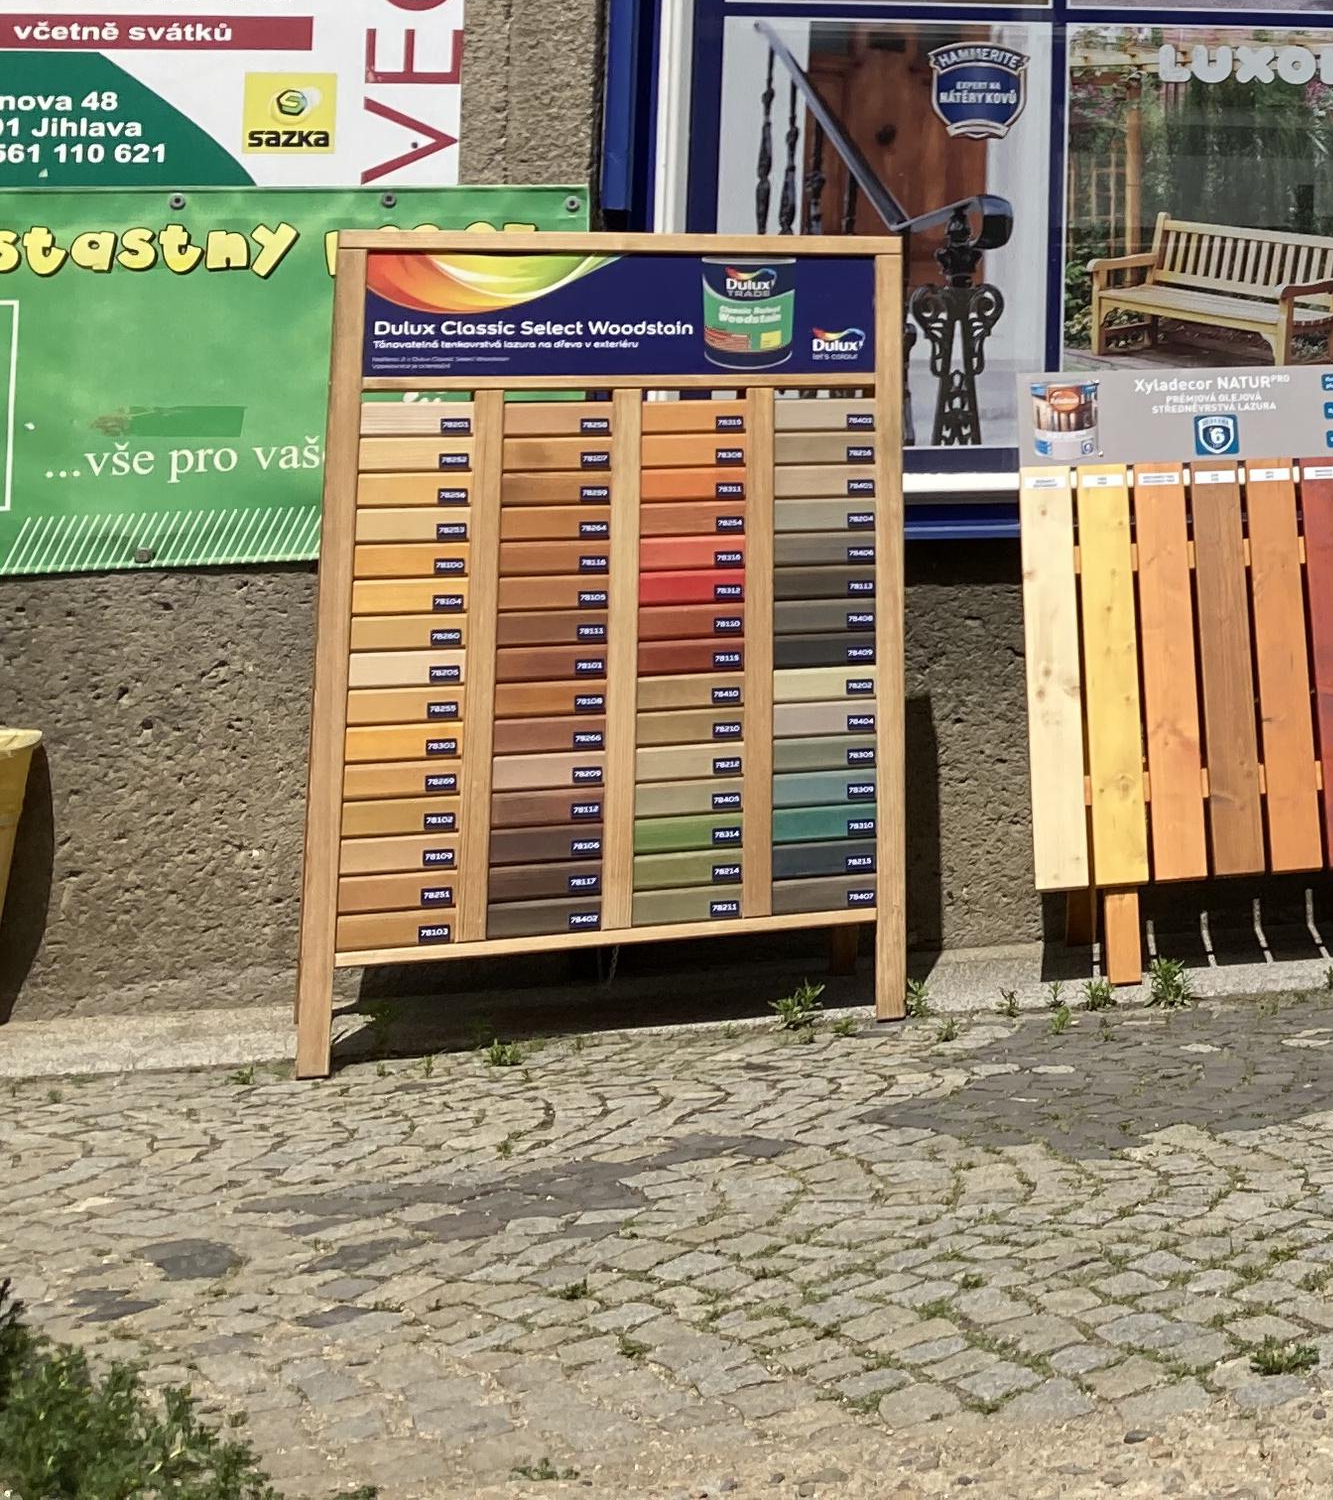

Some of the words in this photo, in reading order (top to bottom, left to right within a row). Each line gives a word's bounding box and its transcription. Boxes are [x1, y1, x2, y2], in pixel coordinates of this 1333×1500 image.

[13, 21, 119, 41] včetně
[128, 21, 233, 43] svátků
[937, 48, 1020, 69] HAMMERITE
[81, 91, 118, 111] 48
[31, 117, 142, 137] Jihlava
[247, 129, 331, 150] sazka
[53, 143, 105, 163] 110
[114, 143, 165, 163] 621
[726, 278, 770, 291] Dulux
[373, 320, 435, 336] Dulux
[440, 320, 515, 336] Classic
[520, 320, 583, 336] Select
[588, 320, 694, 337] Woodstain
[503, 340, 537, 349] lazura
[538, 341, 551, 349] na
[553, 339, 583, 349] dřevo
[594, 338, 639, 350] exteriéru
[812, 339, 858, 352] Dulux
[1134, 378, 1213, 395] Xyladecor
[1166, 391, 1218, 403] PRÉMIOVÁ
[1218, 391, 1263, 402] OLEJOVÁ
[1237, 401, 1278, 411] LAZURA
[1209, 426, 1226, 444] 6
[168, 447, 238, 483] pro
[253, 436, 325, 470] vaš
[426, 815, 454, 824] 78102
[570, 877, 597, 886] 78117
[420, 927, 449, 937] 78103
